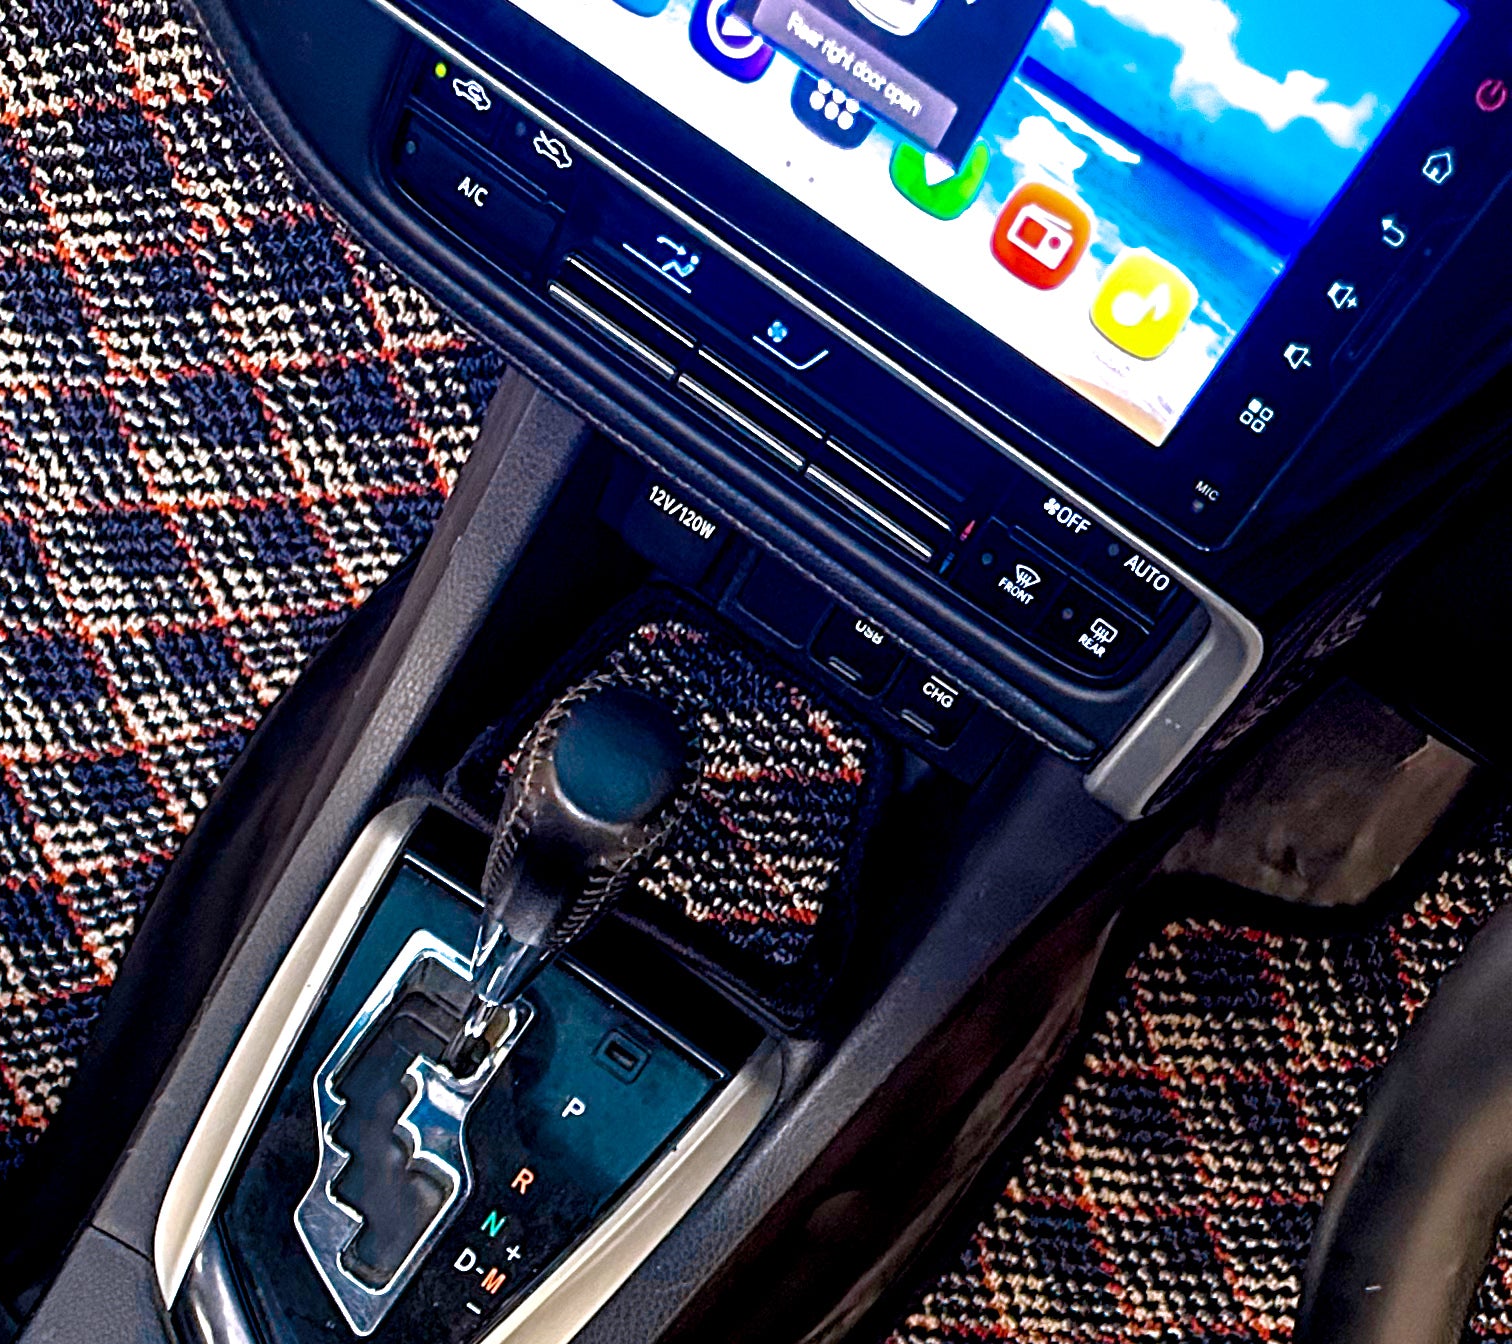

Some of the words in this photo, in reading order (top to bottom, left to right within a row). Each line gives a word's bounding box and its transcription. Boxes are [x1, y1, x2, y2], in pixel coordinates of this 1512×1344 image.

[821, 39, 855, 71] right
[852, 60, 887, 91] door
[884, 82, 922, 117] open
[457, 176, 489, 207] A/C
[1195, 480, 1220, 501] MIC
[649, 485, 716, 539] 12V/120W
[1056, 507, 1091, 533] OFF
[1124, 555, 1170, 591] AUTO
[998, 577, 1034, 605] FRONT
[1078, 633, 1106, 658] REAR
[561, 1097, 586, 1118] P
[511, 1168, 534, 1195] R
[481, 1210, 506, 1237] N
